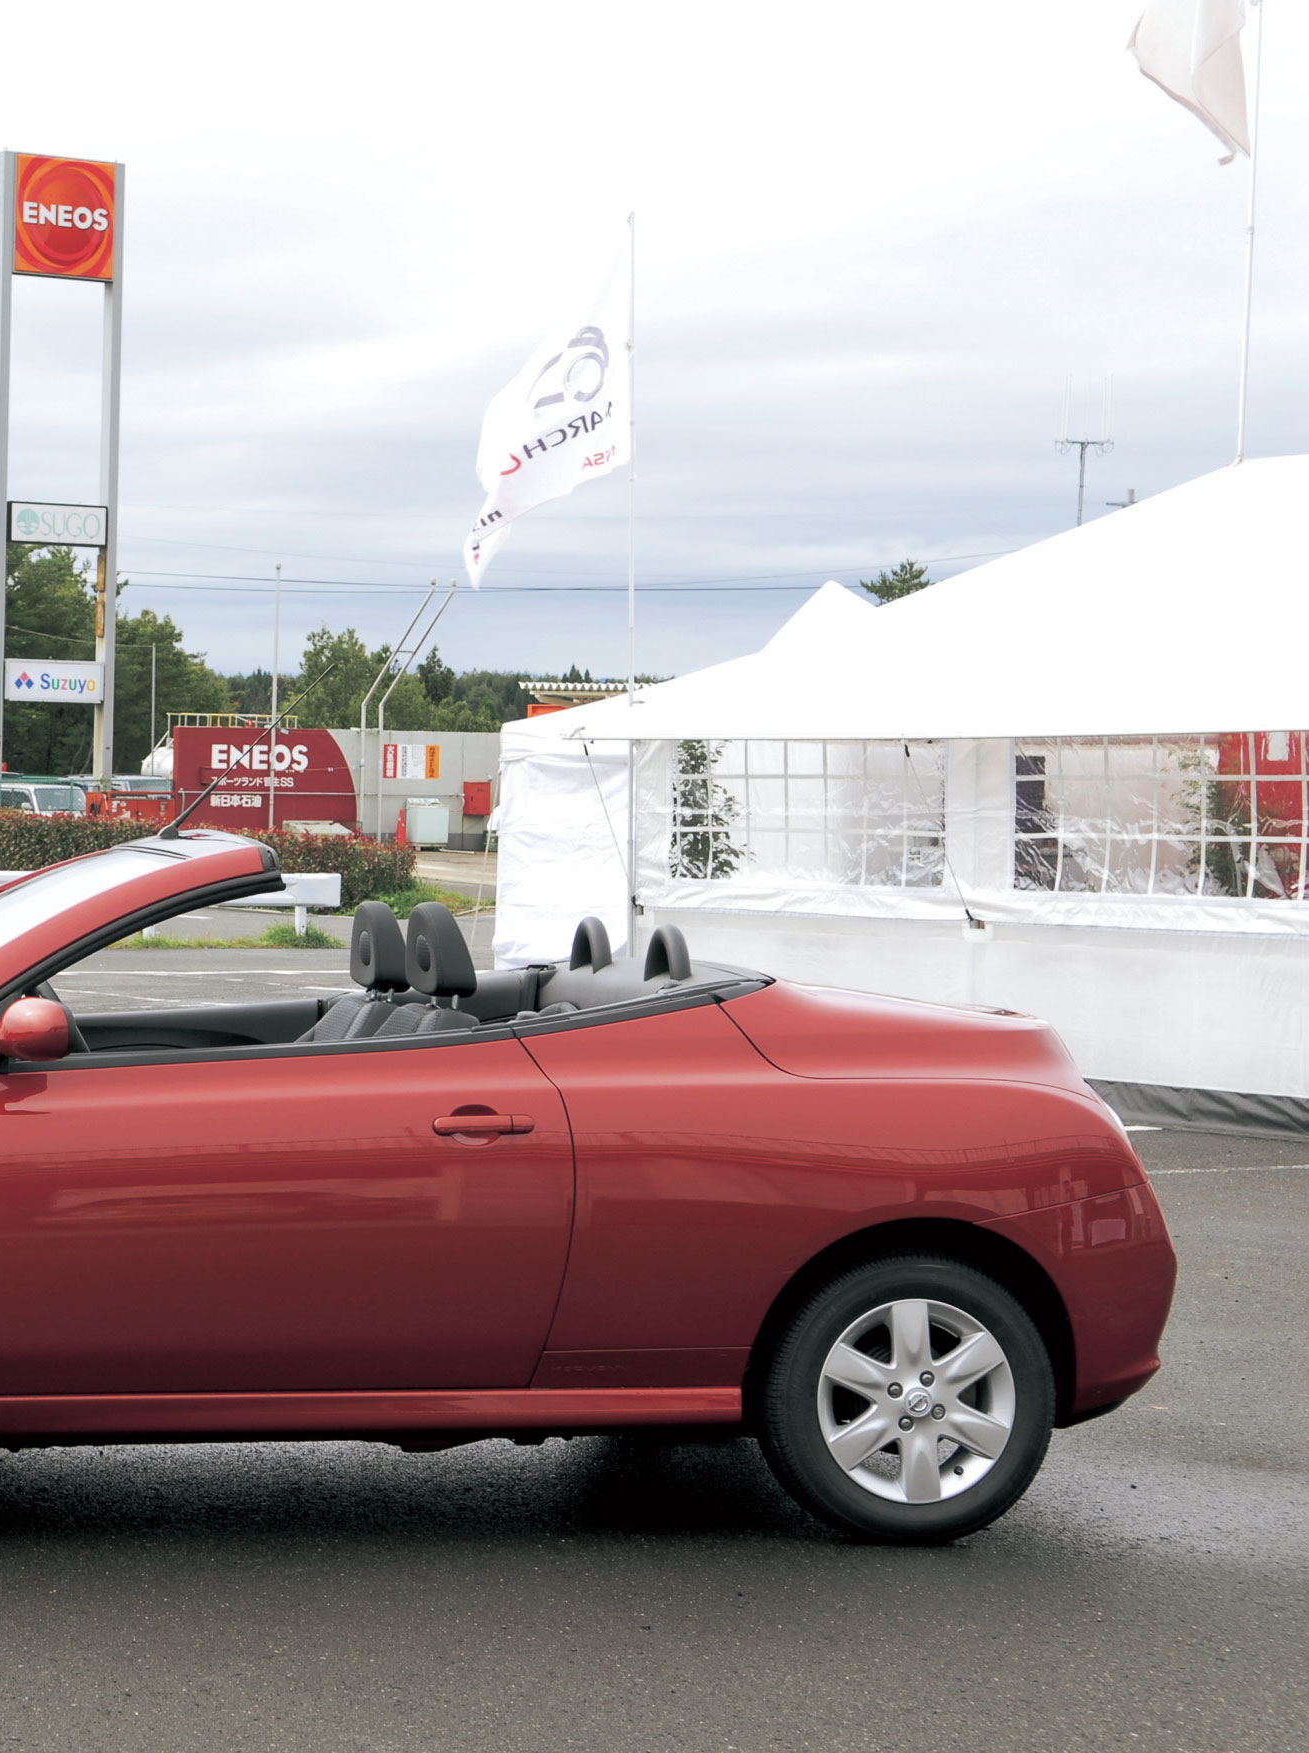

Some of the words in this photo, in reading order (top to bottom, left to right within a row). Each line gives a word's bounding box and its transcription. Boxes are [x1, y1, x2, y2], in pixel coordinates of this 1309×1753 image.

[23, 201, 109, 232] ENEOS
[40, 511, 101, 538] SUGO
[40, 673, 97, 694] Suzuyo
[211, 744, 309, 772] ENEOS
[210, 794, 262, 807] 新日本石油
